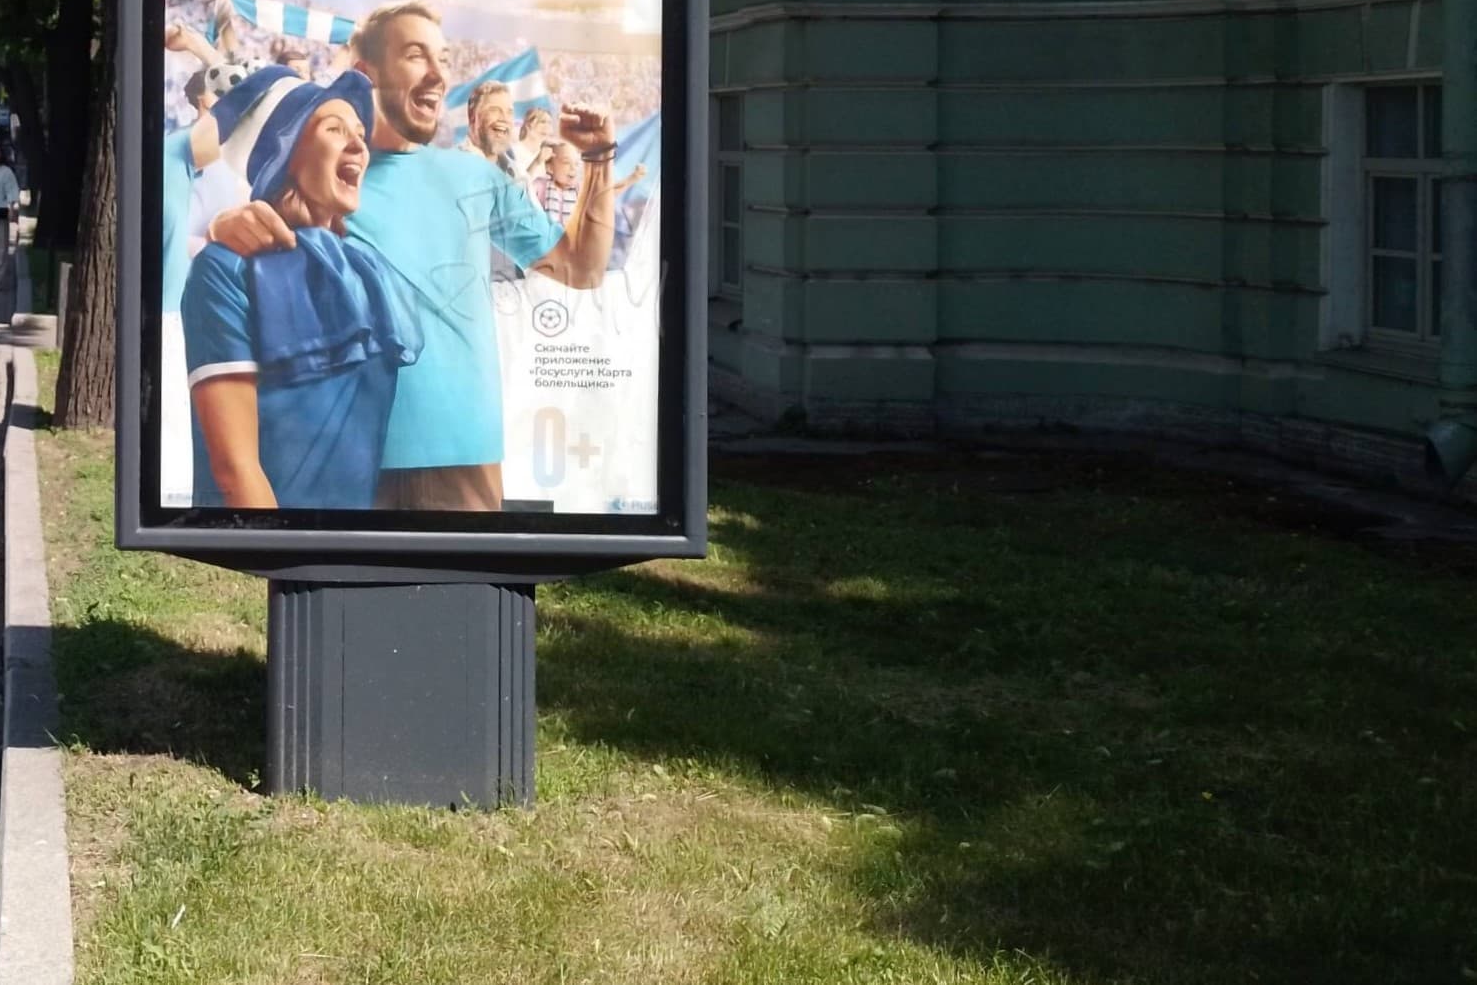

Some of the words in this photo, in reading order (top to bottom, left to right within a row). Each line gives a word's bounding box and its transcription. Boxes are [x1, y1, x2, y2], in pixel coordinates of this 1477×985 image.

[534, 343, 590, 353] Скачайте
[534, 356, 611, 366] приложение
[529, 366, 594, 378] «Госуслуги
[597, 367, 632, 378] Карта
[534, 377, 615, 388] болельщика»
[533, 406, 601, 487] 0+
